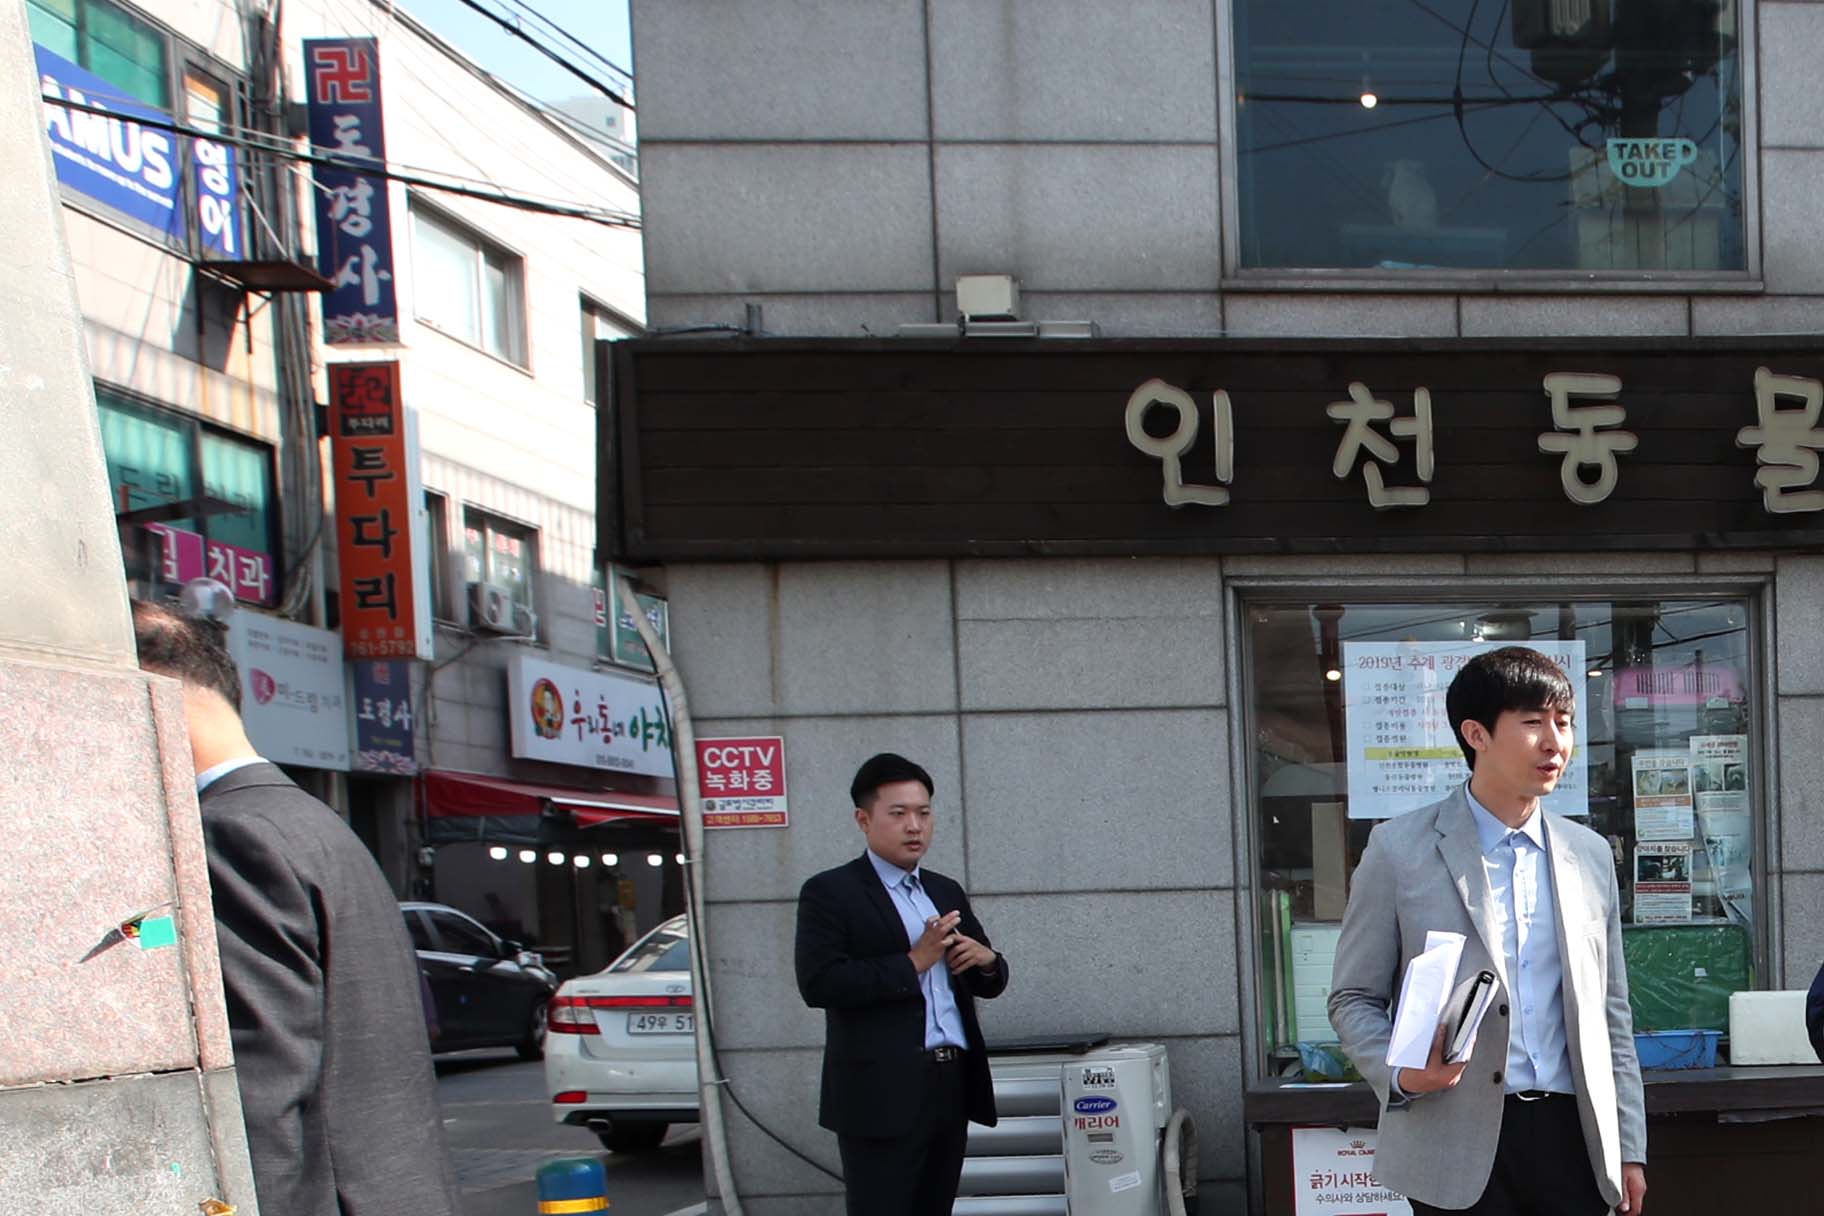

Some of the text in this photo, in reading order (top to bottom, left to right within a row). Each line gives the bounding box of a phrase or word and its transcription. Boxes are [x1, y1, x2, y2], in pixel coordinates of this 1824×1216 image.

[1613, 143, 1677, 160] TAKE
[1621, 162, 1672, 178] OUT
[194, 137, 235, 253] 영어
[347, 447, 398, 620] 투다리
[207, 545, 269, 599] 치과
[1358, 655, 1402, 671] 2019년
[1407, 655, 1436, 670] 추계
[571, 689, 625, 744] 우리동네
[703, 746, 775, 768] CCTV
[705, 769, 774, 792] 녹화중
[1076, 1101, 1112, 1110] Carrier
[1074, 1115, 1121, 1130] 캐리어
[1337, 1149, 1357, 1157] ROYAL
[1315, 1192, 1353, 1205] 수의사와
